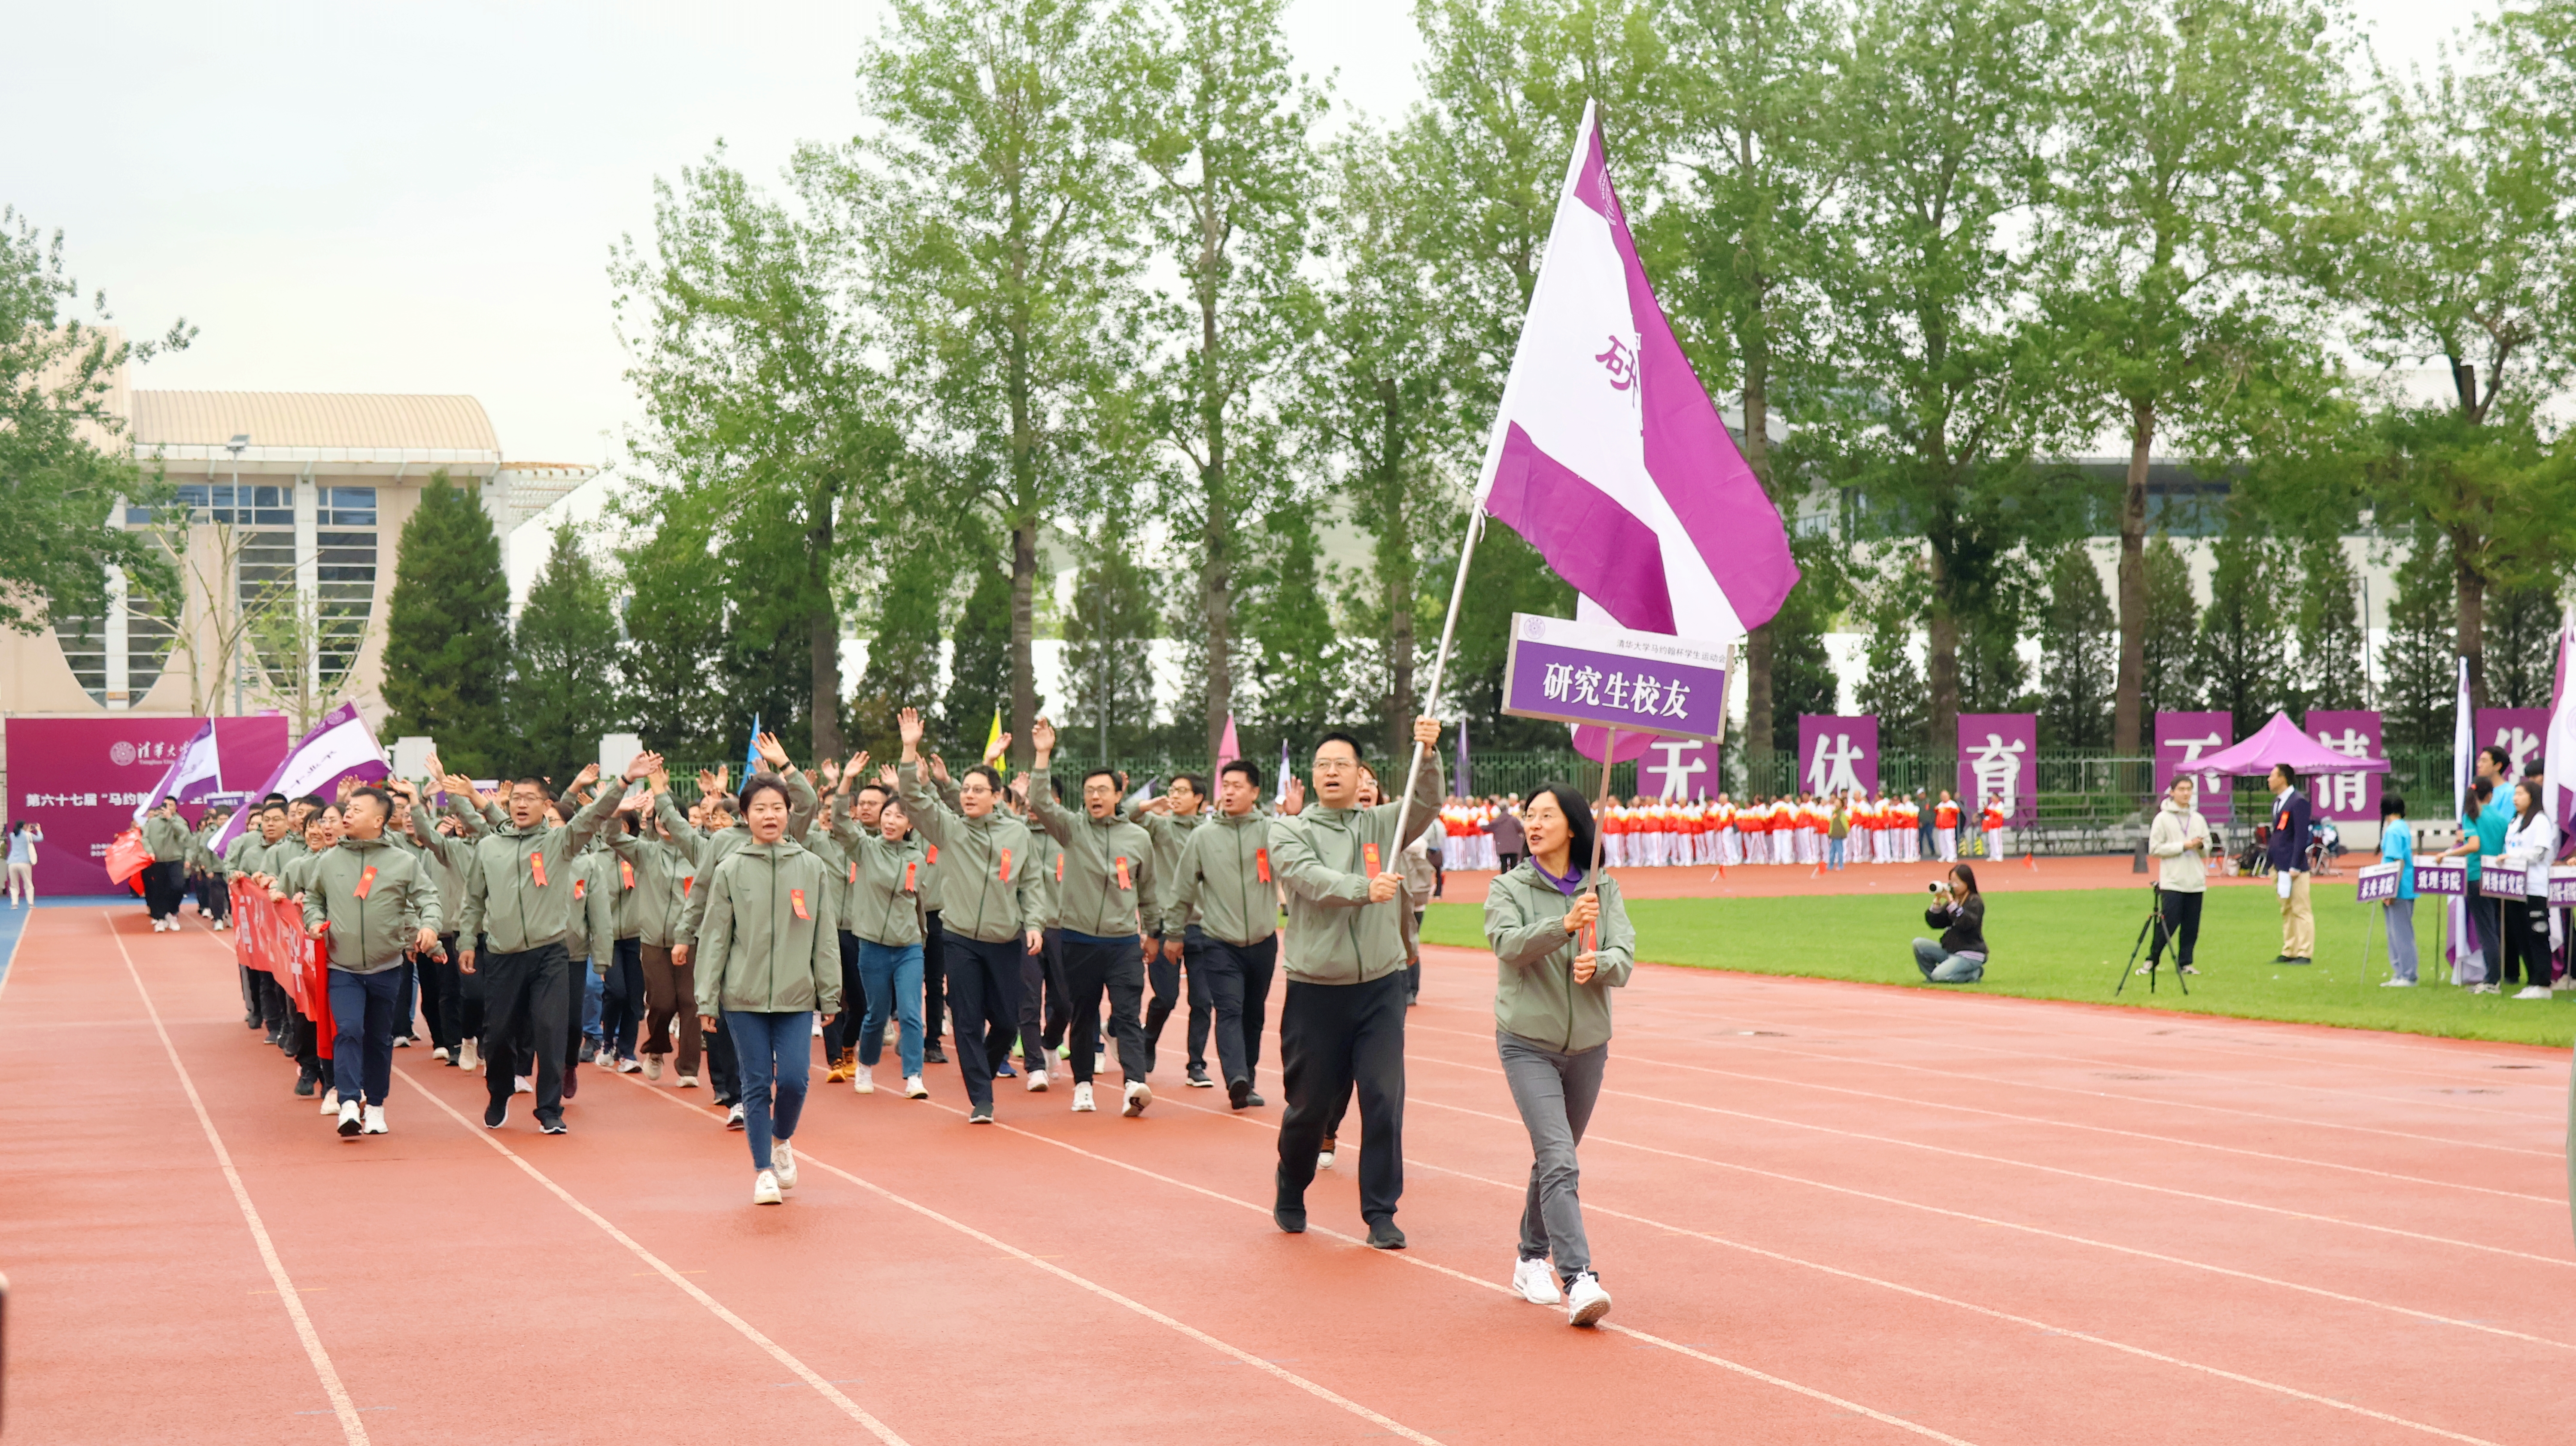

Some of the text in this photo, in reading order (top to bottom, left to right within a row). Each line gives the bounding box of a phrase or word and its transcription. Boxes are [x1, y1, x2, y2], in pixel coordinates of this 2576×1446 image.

[1617, 639, 1726, 664] 清华大学马约翰杯学生运动会
[1543, 662, 1690, 720] 研究生校友
[1965, 733, 2026, 819] 育
